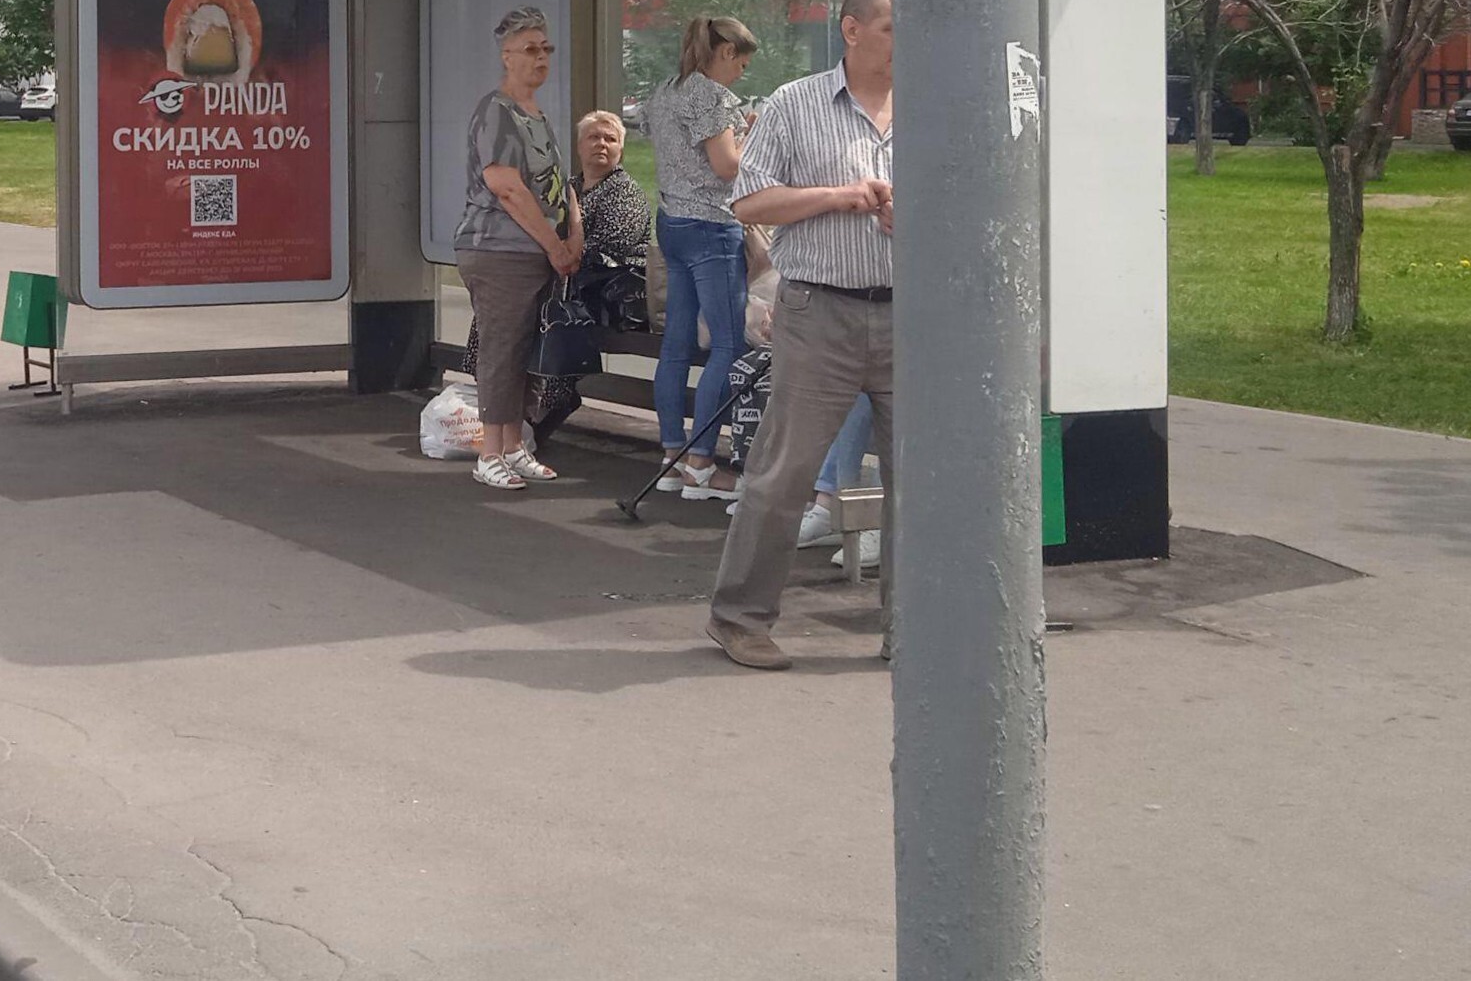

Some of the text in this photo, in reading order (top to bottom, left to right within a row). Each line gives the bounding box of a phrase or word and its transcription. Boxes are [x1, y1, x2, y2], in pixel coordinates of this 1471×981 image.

[203, 82, 287, 116] PANDA
[112, 126, 311, 156] СКИДКА 10%
[167, 158, 260, 170] НА ВСЕ РОЛЛЫ
[192, 230, 237, 239] ЯНДЕКС ЕДА
